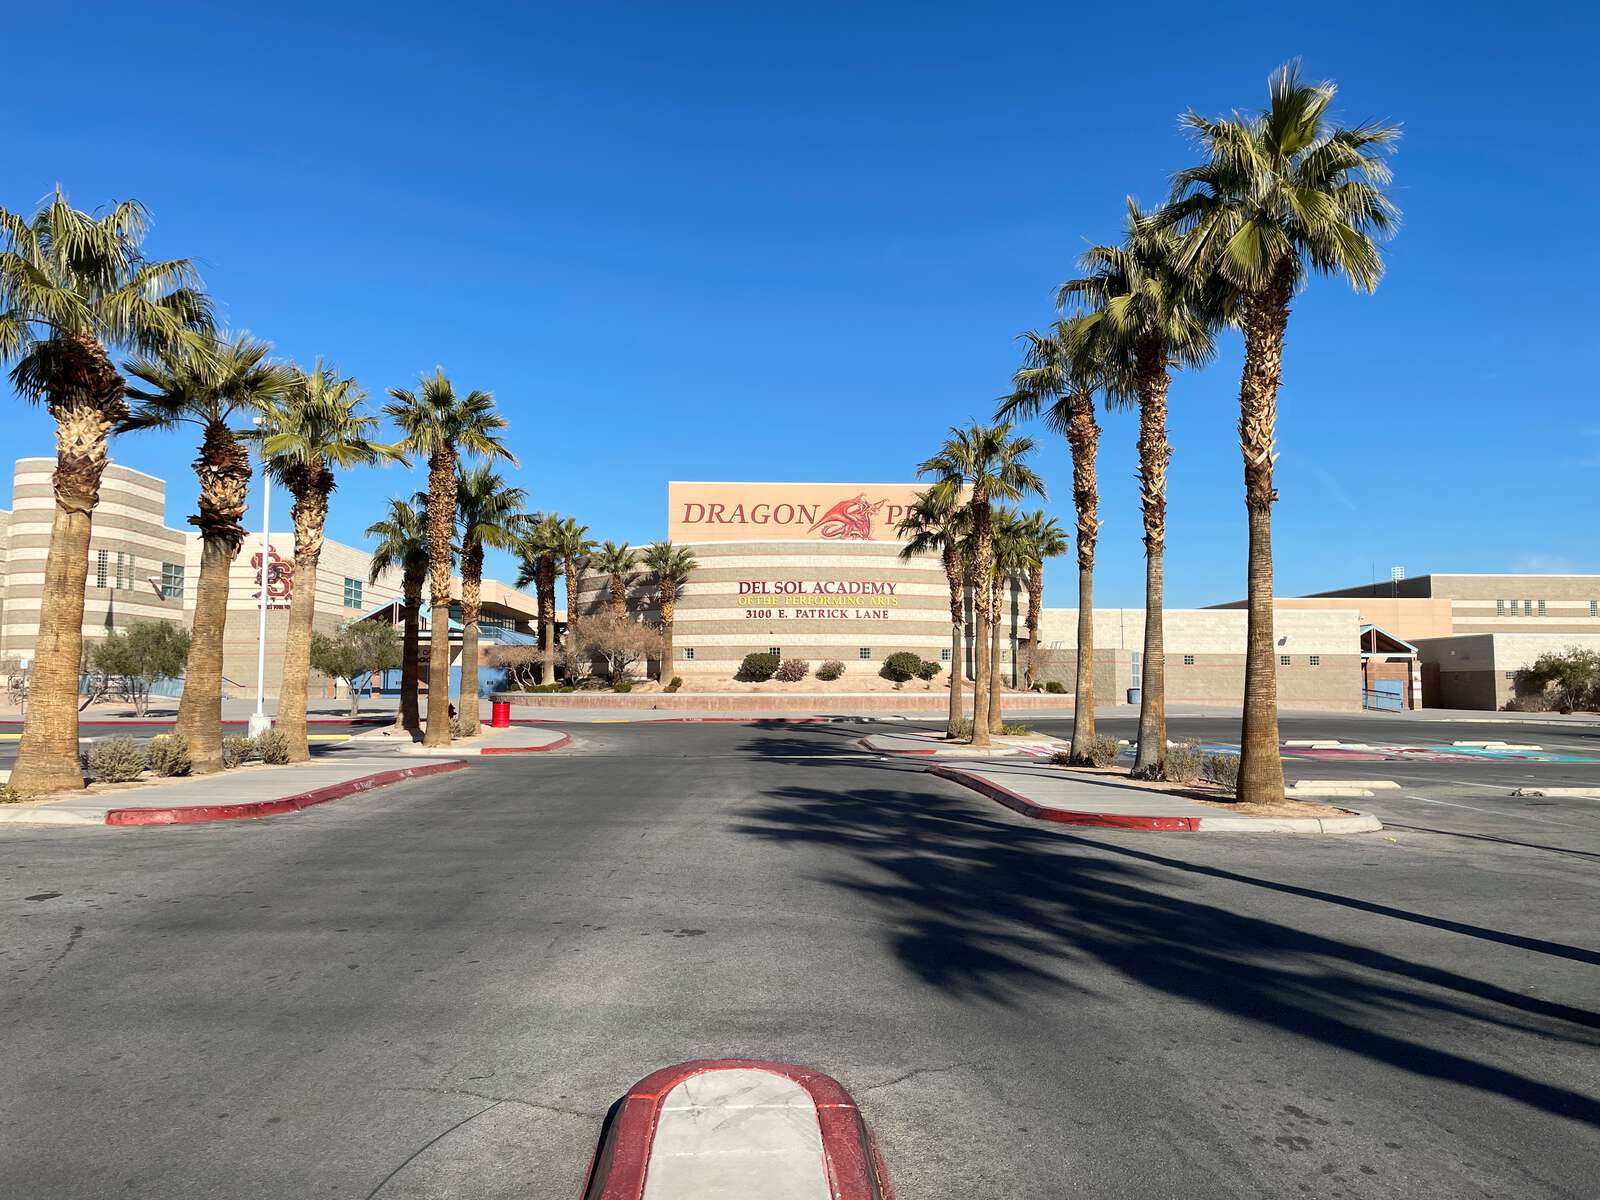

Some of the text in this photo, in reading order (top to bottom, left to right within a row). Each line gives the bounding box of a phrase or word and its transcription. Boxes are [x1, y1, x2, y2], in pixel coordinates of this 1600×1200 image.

[682, 503, 820, 525] DRAGON
[739, 581, 896, 595] DEL SOL ACADEMY
[738, 596, 898, 605] OF THE PERFORMING ARTS
[746, 609, 889, 619] 3100 E. PATRICK LANE
